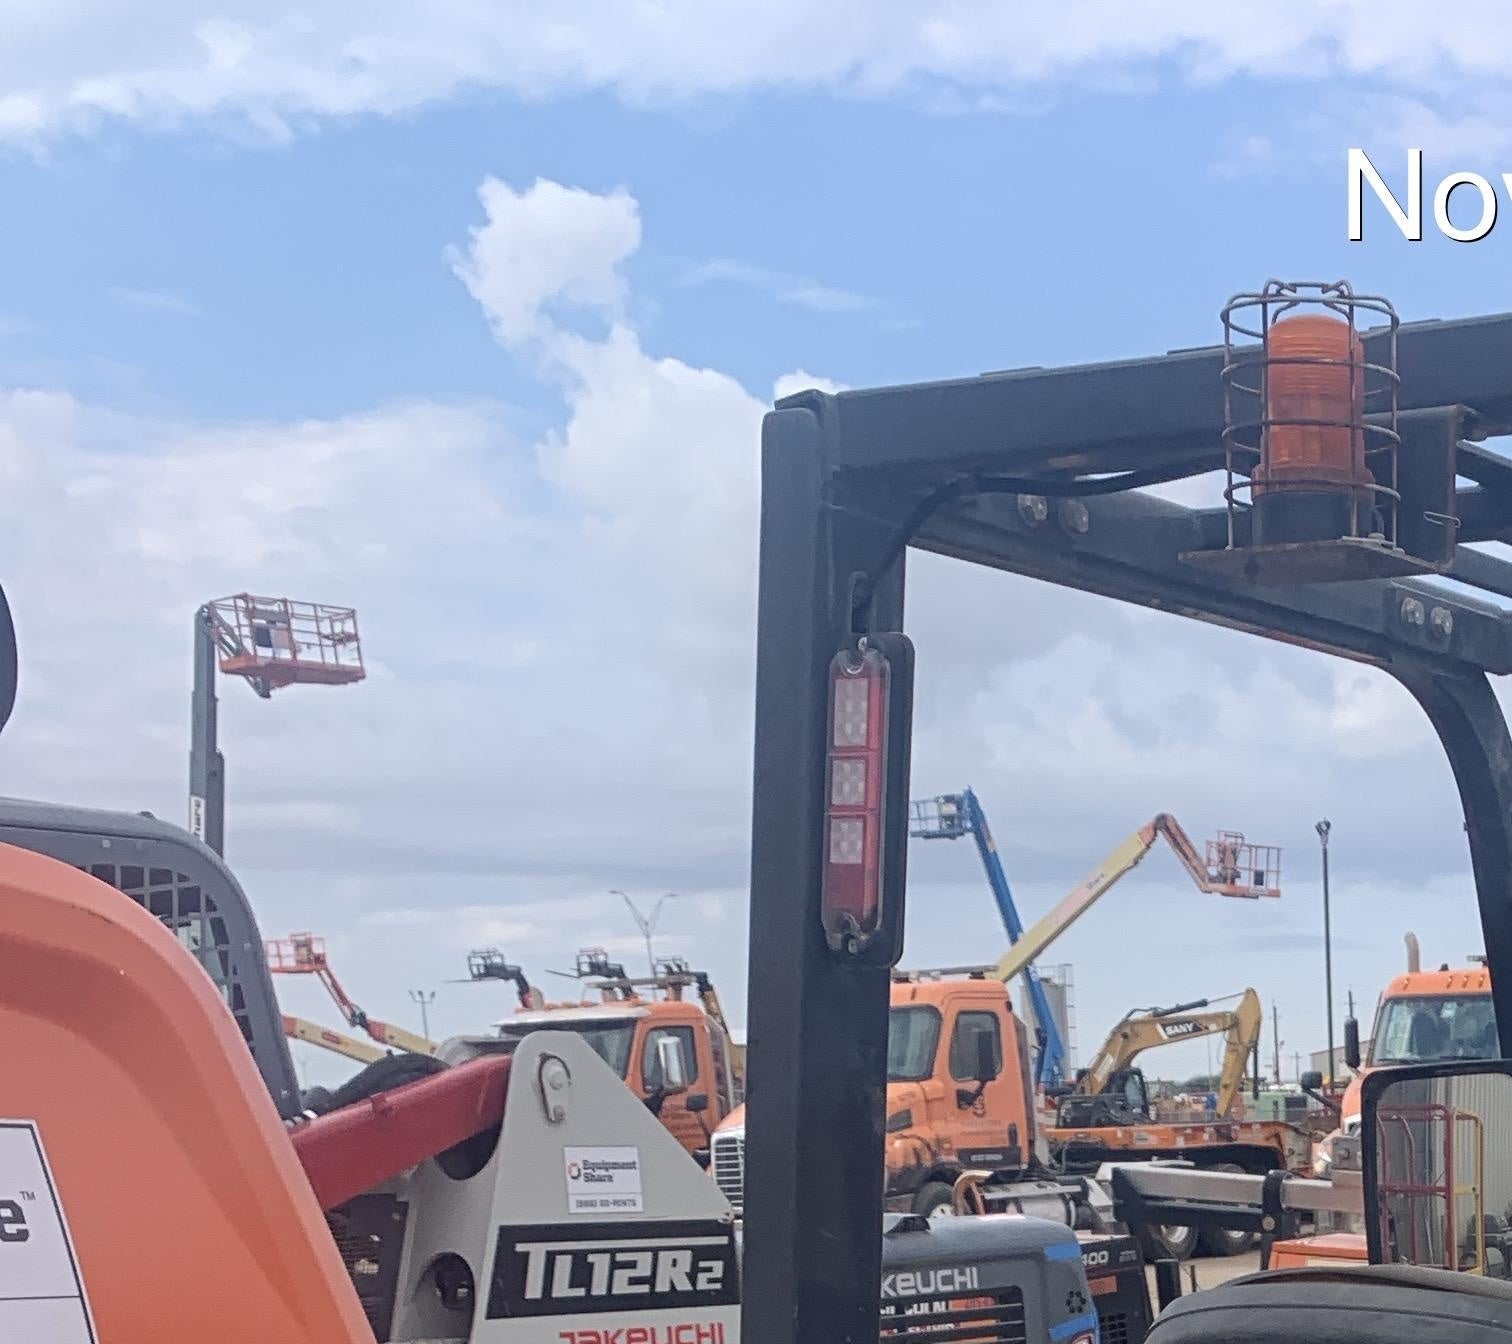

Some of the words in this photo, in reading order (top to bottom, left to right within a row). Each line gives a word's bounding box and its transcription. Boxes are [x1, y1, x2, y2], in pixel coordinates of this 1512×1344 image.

[1165, 1023, 1194, 1037] SANY
[583, 1160, 636, 1172] Equipment
[584, 1173, 613, 1183] Share
[515, 1236, 729, 1300] TL12R2
